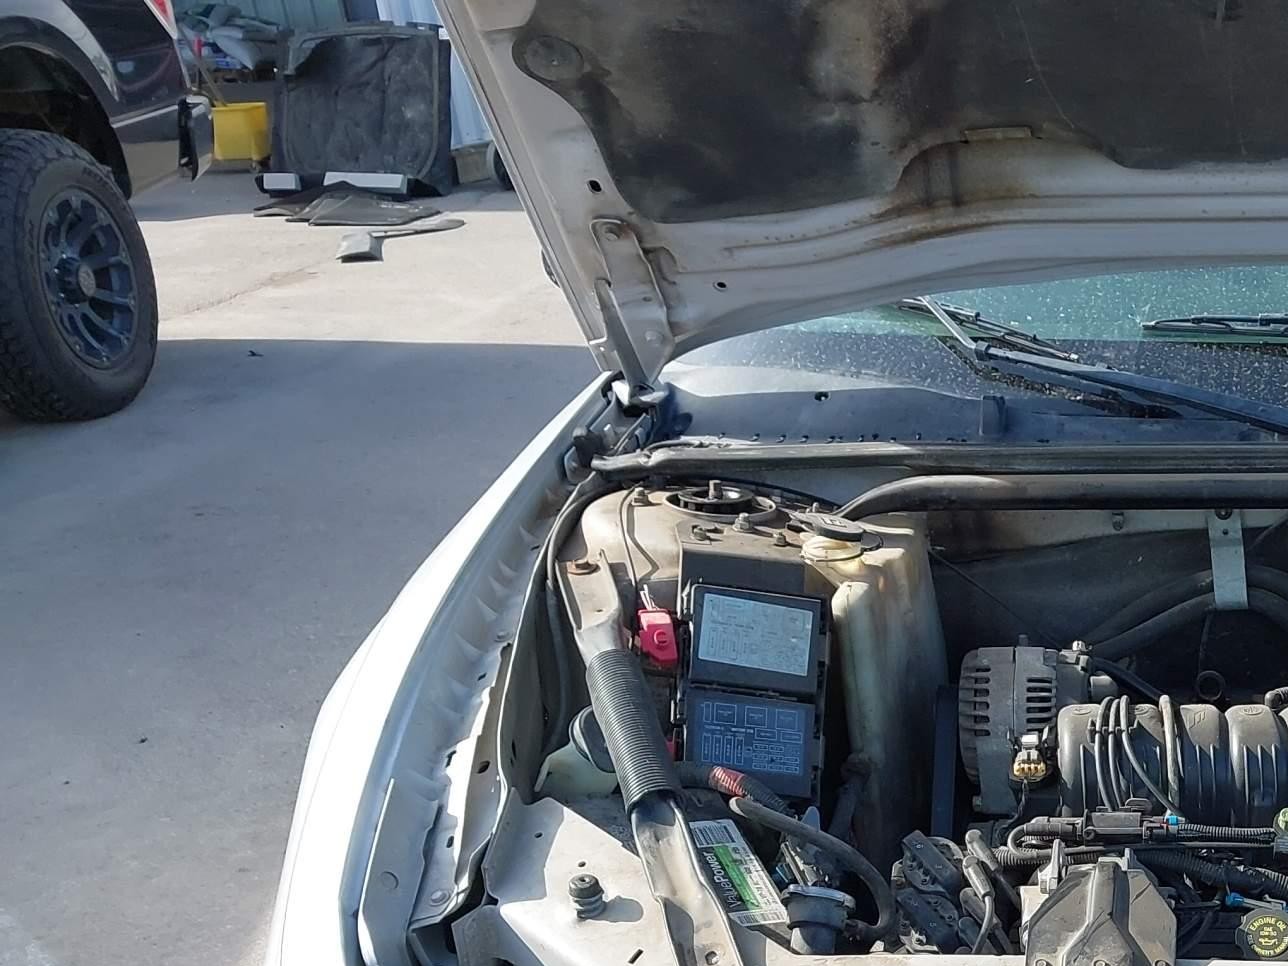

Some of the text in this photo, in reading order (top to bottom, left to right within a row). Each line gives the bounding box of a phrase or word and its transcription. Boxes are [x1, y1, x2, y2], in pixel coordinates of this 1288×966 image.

[703, 852, 742, 908] ValuePower
[1250, 917, 1288, 932] ENGINE OIL
